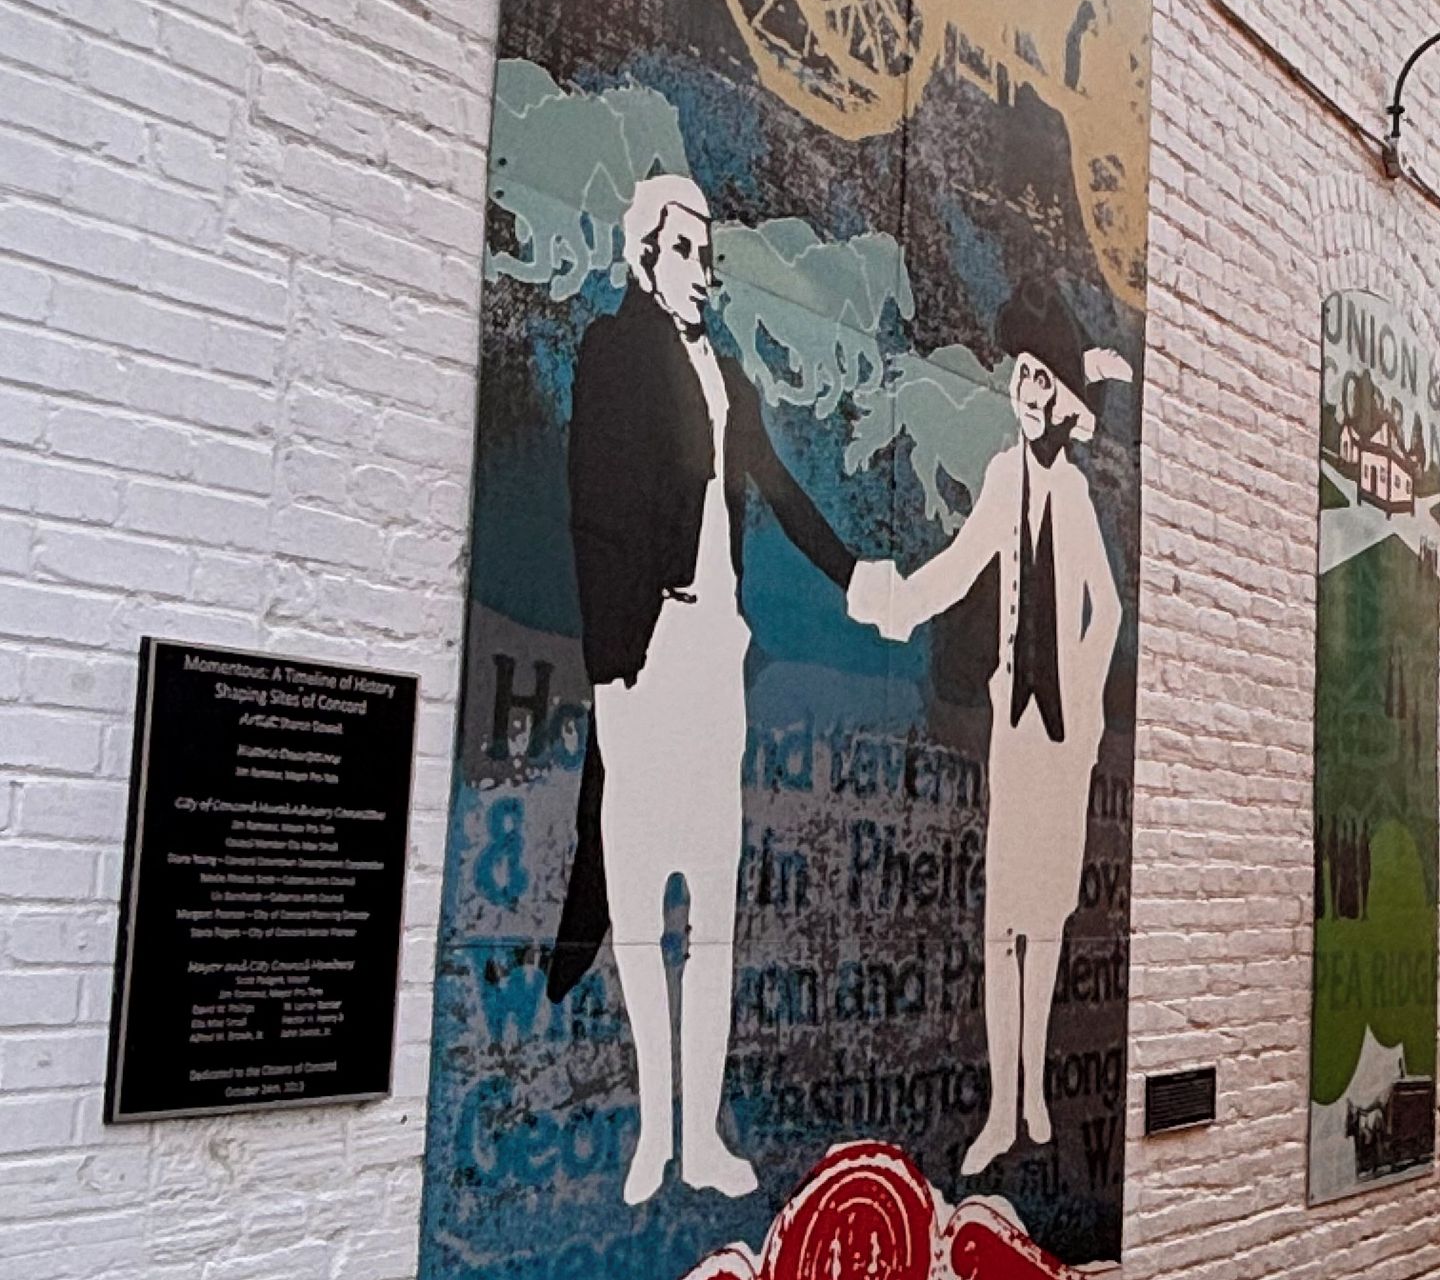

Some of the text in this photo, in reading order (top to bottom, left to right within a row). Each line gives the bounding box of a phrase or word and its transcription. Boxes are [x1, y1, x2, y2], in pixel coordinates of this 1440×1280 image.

[1324, 291, 1419, 397] UNION
[213, 682, 268, 707] Shaping
[300, 692, 315, 710] of
[317, 694, 367, 716] Concord
[270, 666, 282, 681] A
[283, 667, 337, 689] Timeline
[338, 673, 352, 691] of
[352, 676, 396, 699] History
